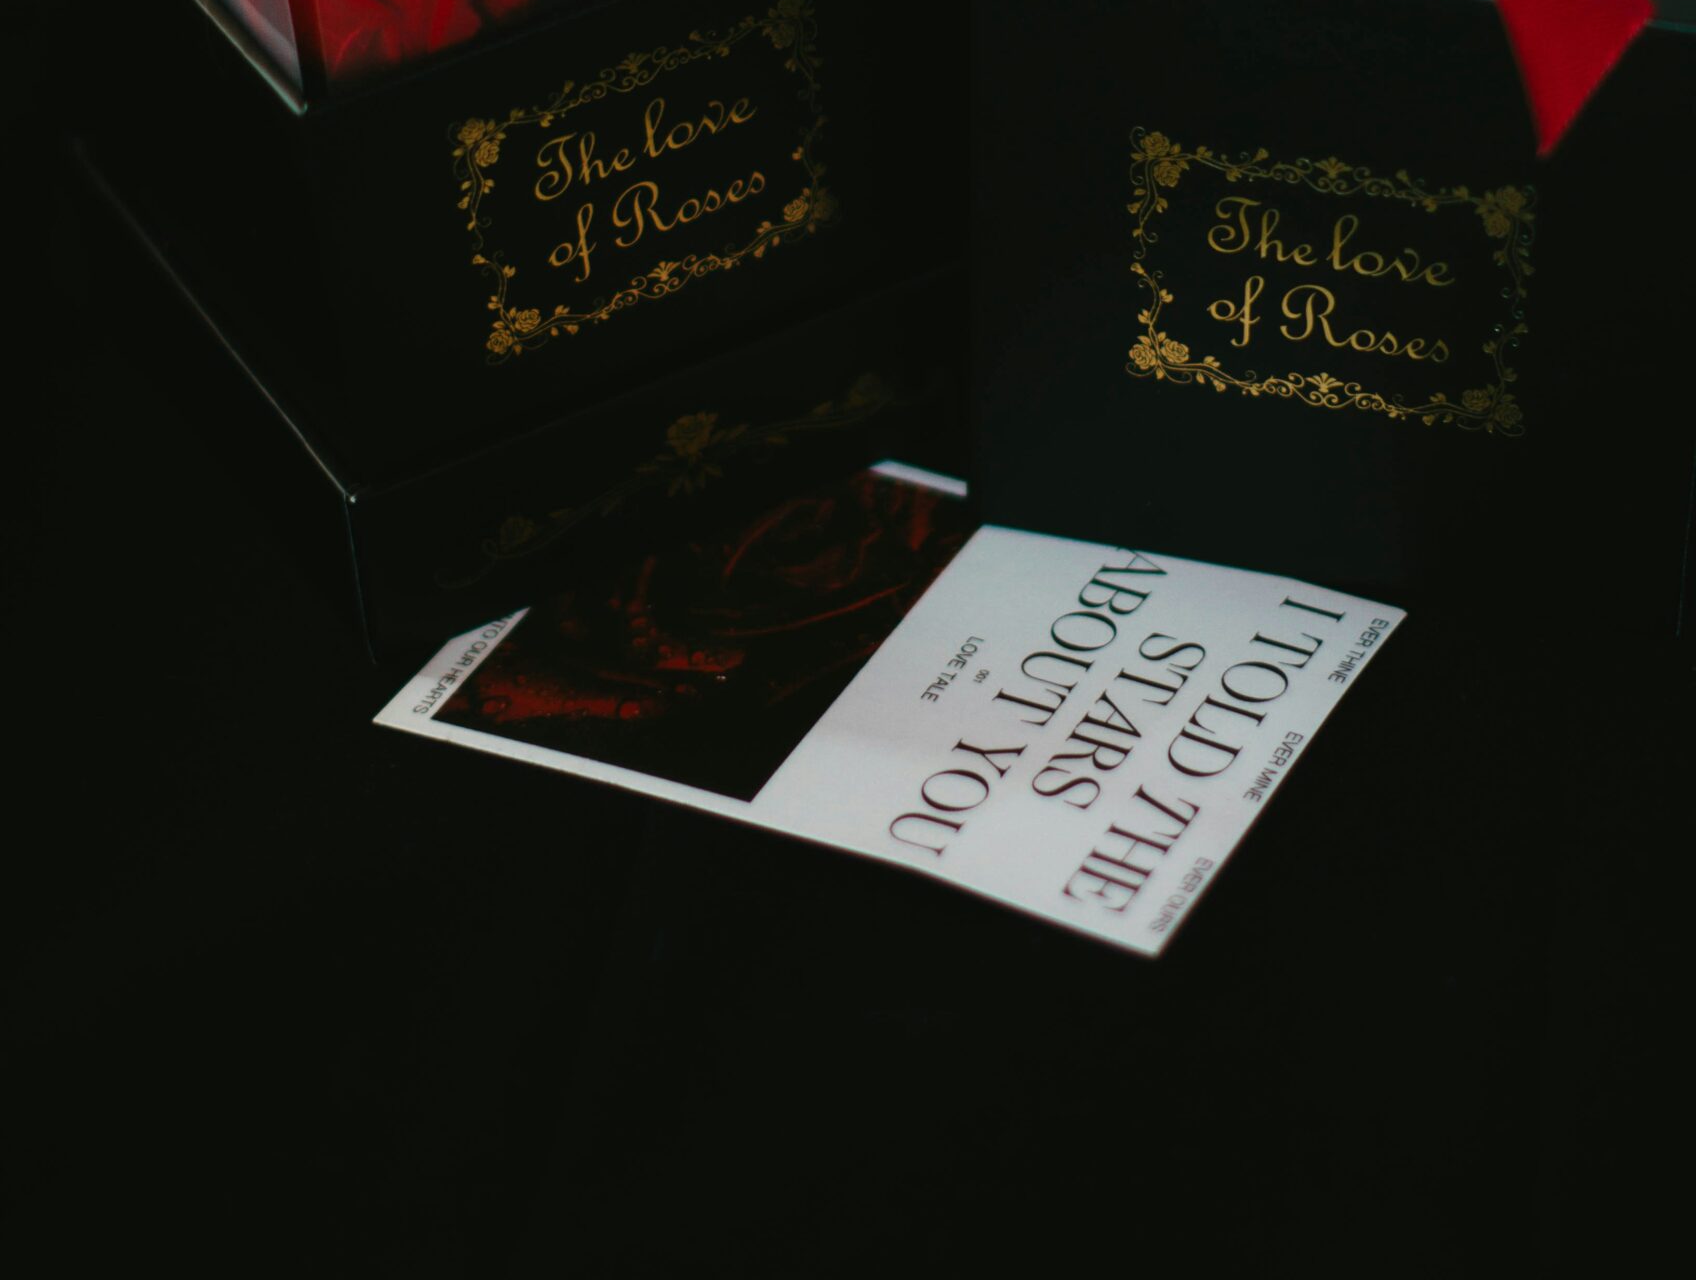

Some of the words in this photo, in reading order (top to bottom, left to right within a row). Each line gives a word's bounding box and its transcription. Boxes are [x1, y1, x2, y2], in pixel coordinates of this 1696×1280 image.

[534, 130, 637, 202] The
[643, 97, 758, 158] love
[547, 202, 598, 285] of
[612, 170, 766, 248] Roses
[1206, 196, 1318, 267] The
[1326, 214, 1456, 287] love
[1206, 275, 1266, 348] of
[1278, 283, 1450, 364] Roses
[991, 547, 1169, 727] ABOUT
[1278, 595, 1347, 623] I
[1354, 618, 1390, 648] EVER
[455, 640, 488, 667] OUR
[946, 635, 985, 670] LOVE
[1327, 649, 1367, 684] THINE
[411, 667, 464, 715] HEARTS
[920, 671, 958, 703] TALE
[1031, 631, 1207, 810] STARS
[1167, 630, 1324, 779] TOLD
[1268, 730, 1304, 768] EVER
[888, 738, 1028, 857] YOU
[1243, 767, 1279, 803] MINE
[1062, 783, 1201, 914] THE
